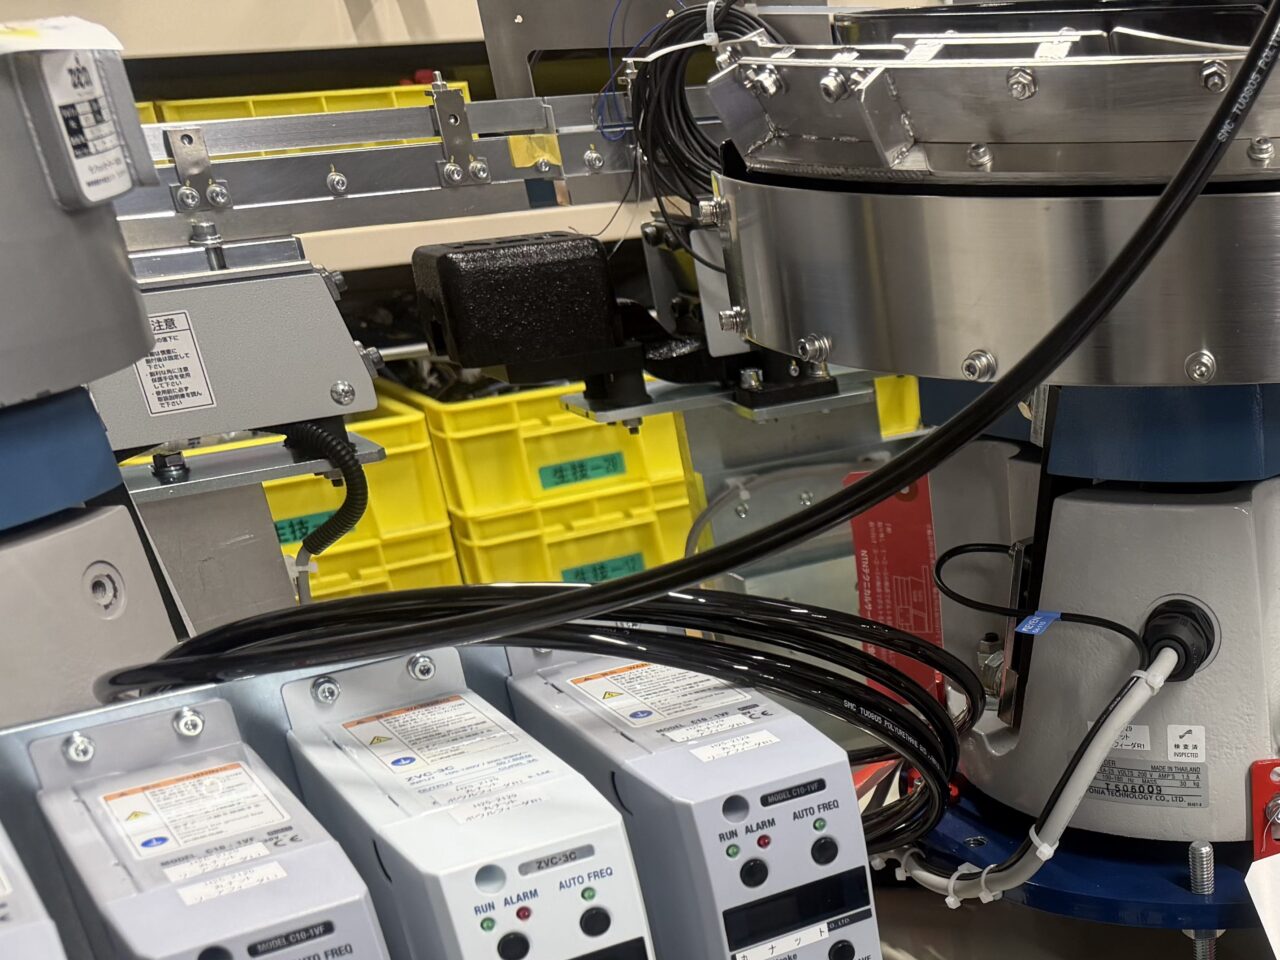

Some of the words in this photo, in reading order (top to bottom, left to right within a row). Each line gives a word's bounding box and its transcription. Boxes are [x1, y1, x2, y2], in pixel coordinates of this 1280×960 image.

[1217, 120, 1235, 143] SMC
[151, 318, 177, 332] 注意
[843, 700, 857, 711] SMC
[767, 791, 791, 804] MODEL
[1107, 789, 1153, 800] TECHNOLOGY
[792, 808, 815, 821] AUTO
[817, 799, 840, 814] FREQ
[744, 817, 776, 835] ALARM
[718, 829, 739, 843] RUN
[535, 851, 578, 871] ZVC-3C
[558, 875, 585, 891] AUTO
[587, 866, 614, 883] FREQ
[503, 888, 540, 908] ALARM
[473, 901, 496, 916] RUN
[257, 937, 287, 954] MODEL
